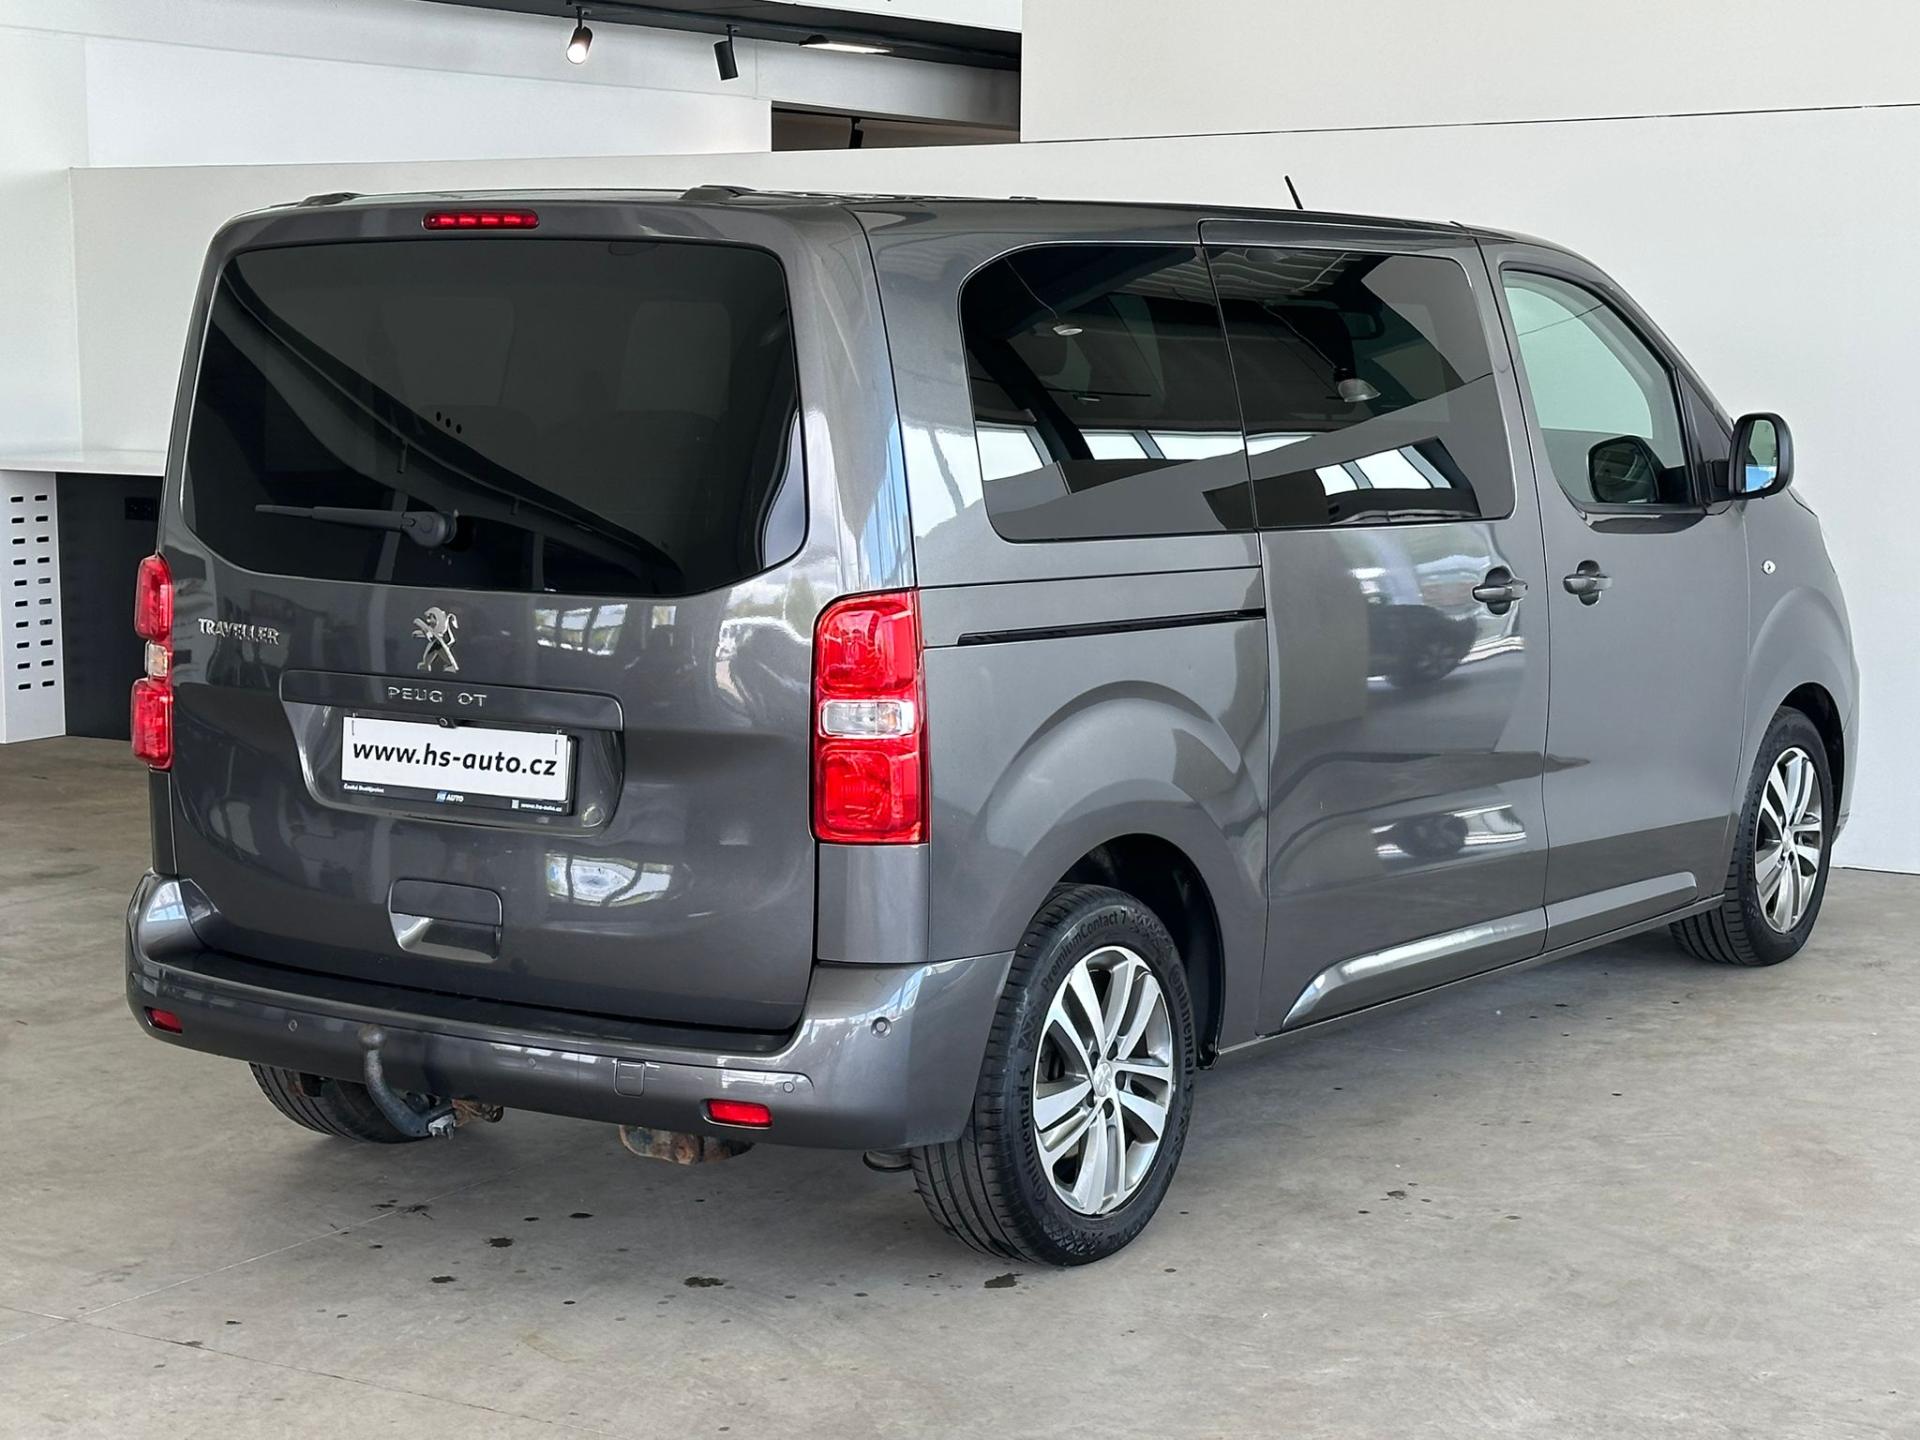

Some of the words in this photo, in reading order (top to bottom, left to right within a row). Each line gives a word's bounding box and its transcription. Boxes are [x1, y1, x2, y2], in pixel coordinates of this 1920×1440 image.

[197, 618, 280, 645] TRAVELLER
[388, 686, 487, 707] PEUGOT
[353, 742, 557, 777] www.hs-auto.cz
[1041, 911, 1118, 991] PremiumContact
[1120, 909, 1128, 925] 7
[1168, 963, 1195, 1075] Continental
[1018, 1084, 1048, 1201] Continental
